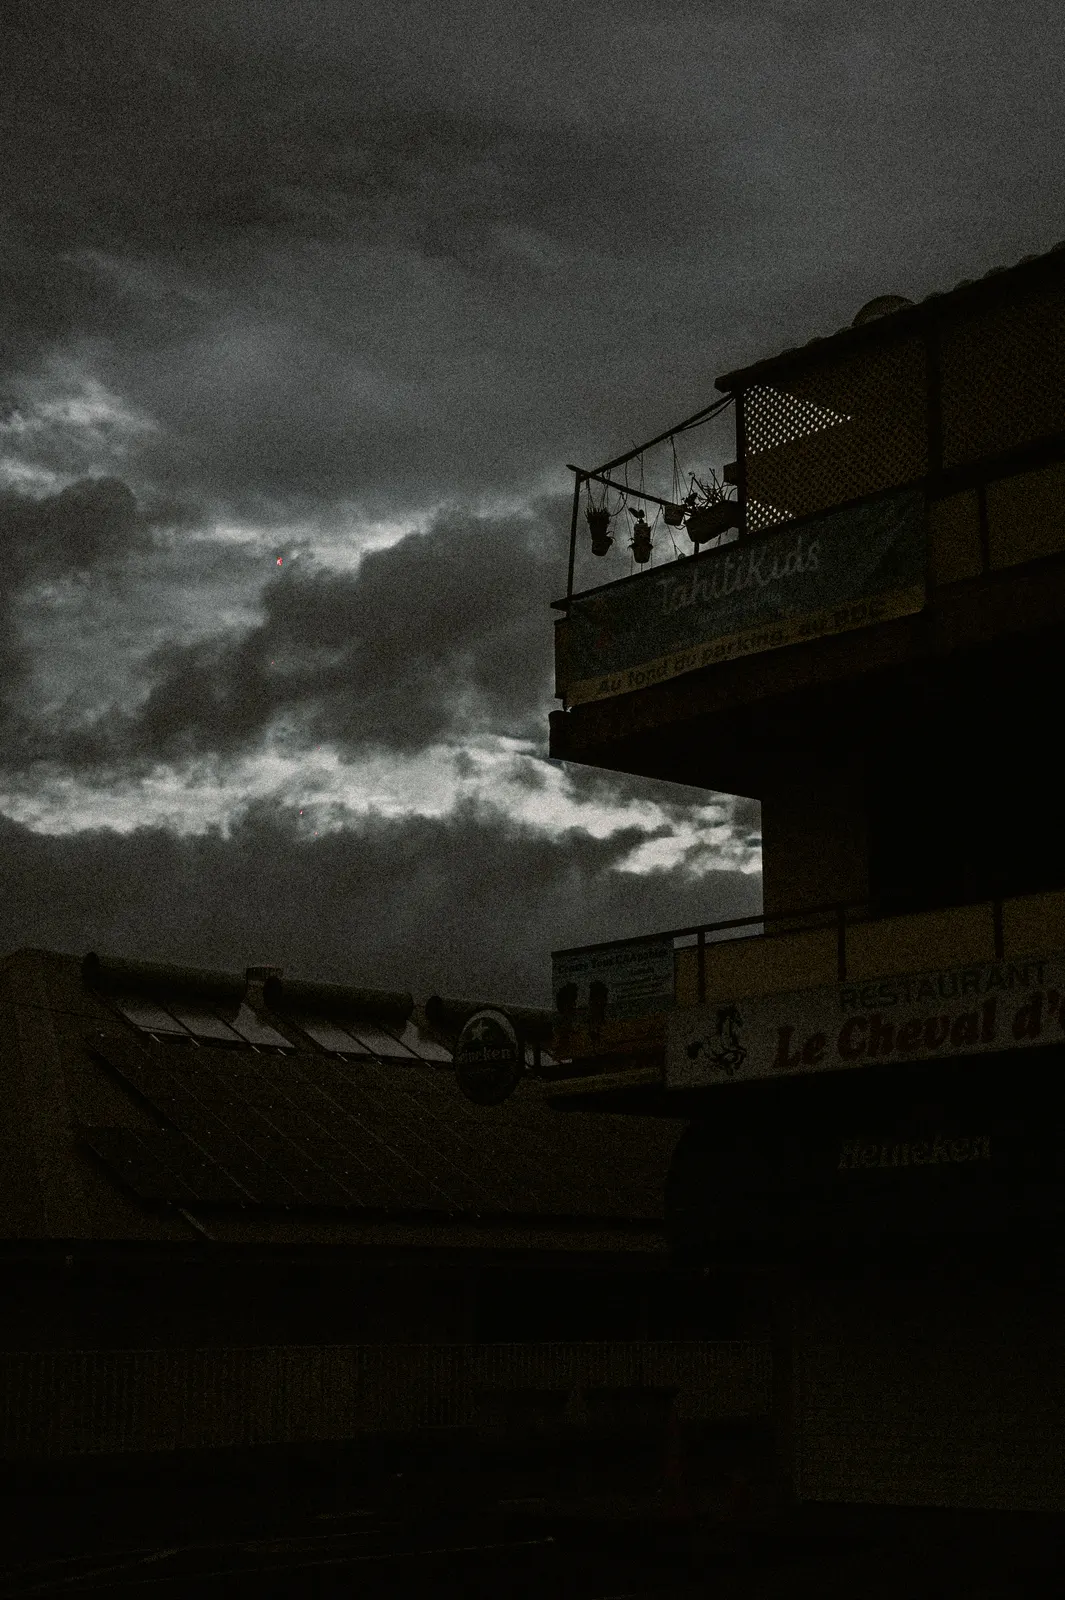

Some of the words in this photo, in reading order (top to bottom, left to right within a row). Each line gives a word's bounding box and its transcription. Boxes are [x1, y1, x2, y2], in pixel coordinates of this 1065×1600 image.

[628, 665, 668, 688] fond
[674, 655, 697, 672] du
[838, 960, 1048, 1012] RESTAURANT
[771, 1025, 827, 1069] Le
[836, 996, 998, 1061] Cheval
[1011, 988, 1065, 1041] d'
[836, 1133, 992, 1170] Heineken
